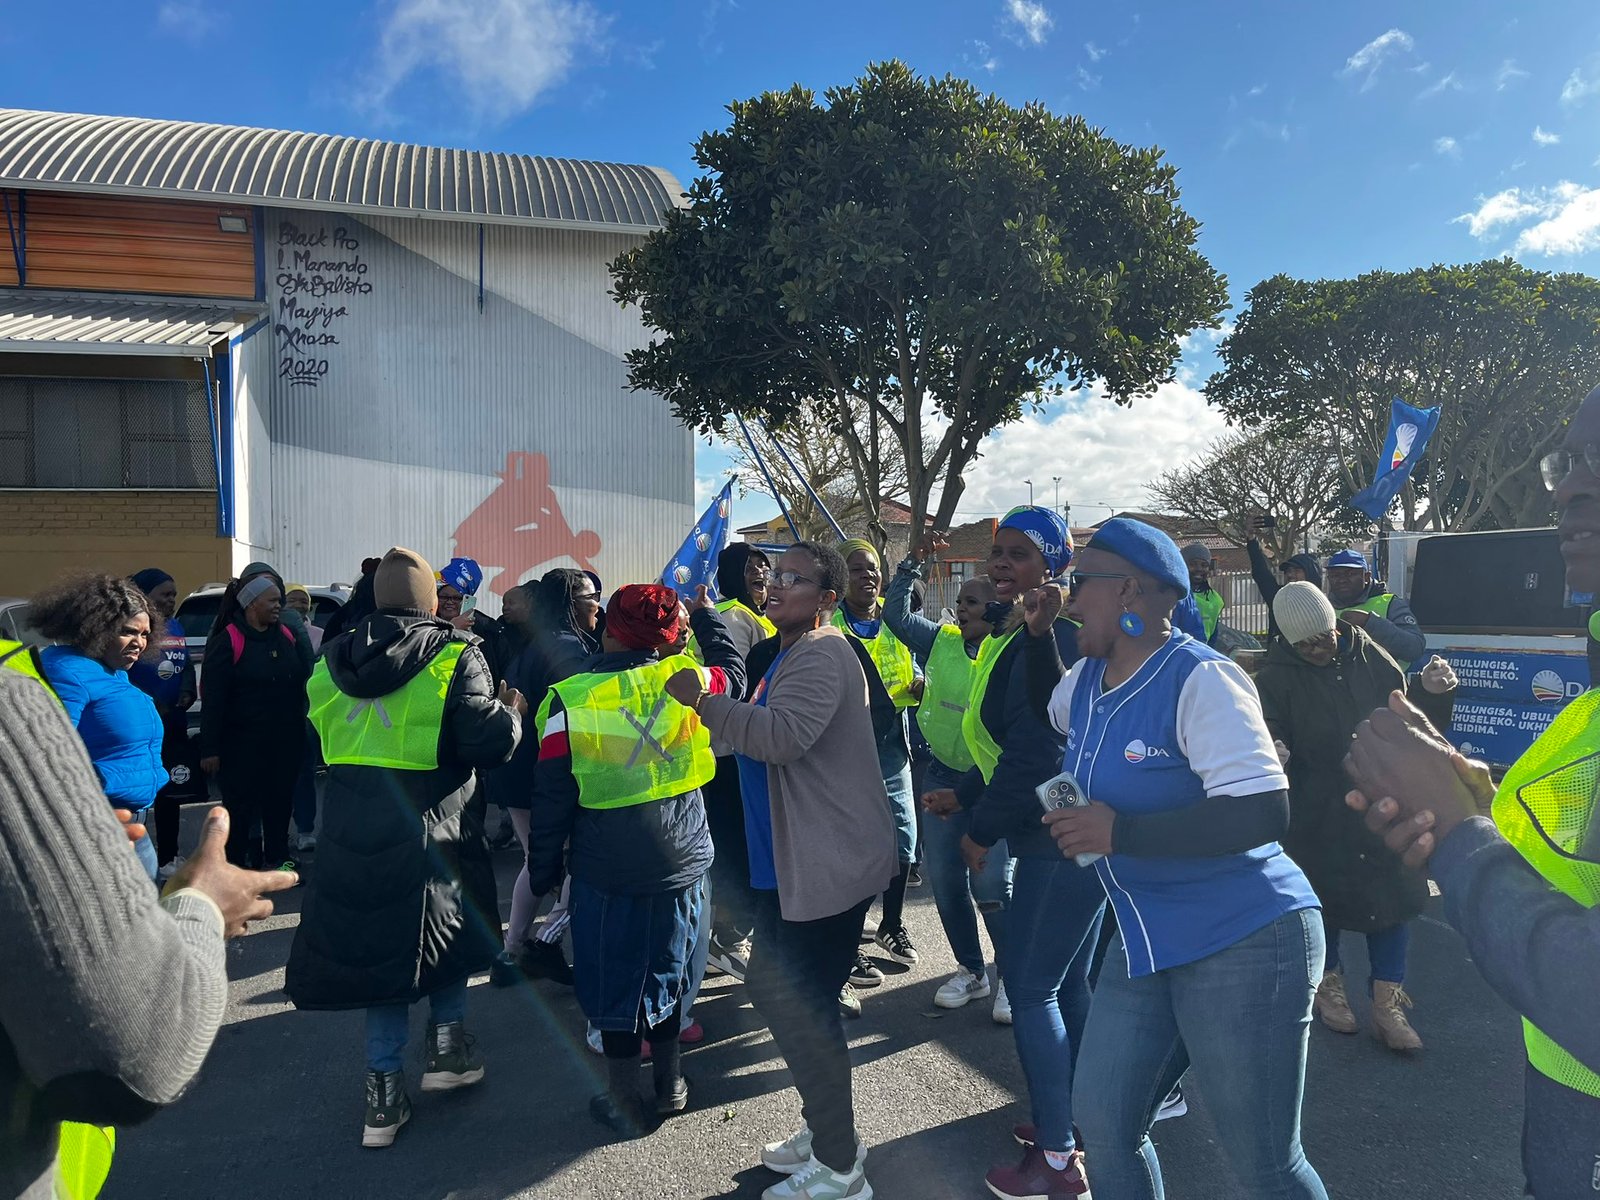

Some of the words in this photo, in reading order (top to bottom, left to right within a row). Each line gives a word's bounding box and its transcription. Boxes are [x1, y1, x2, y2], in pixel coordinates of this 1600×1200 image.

[277, 222, 328, 247] Black
[333, 226, 359, 250] Pro
[279, 357, 329, 377] 2020
[1045, 542, 1063, 557] DA
[165, 651, 185, 660] Vote
[1452, 704, 1517, 717] BULUNGISA.
[1450, 713, 1516, 727] HUSELEKO.
[1453, 723, 1498, 735] ISIDIMA.
[1147, 746, 1170, 758] DA
[1472, 746, 1486, 754] DA
